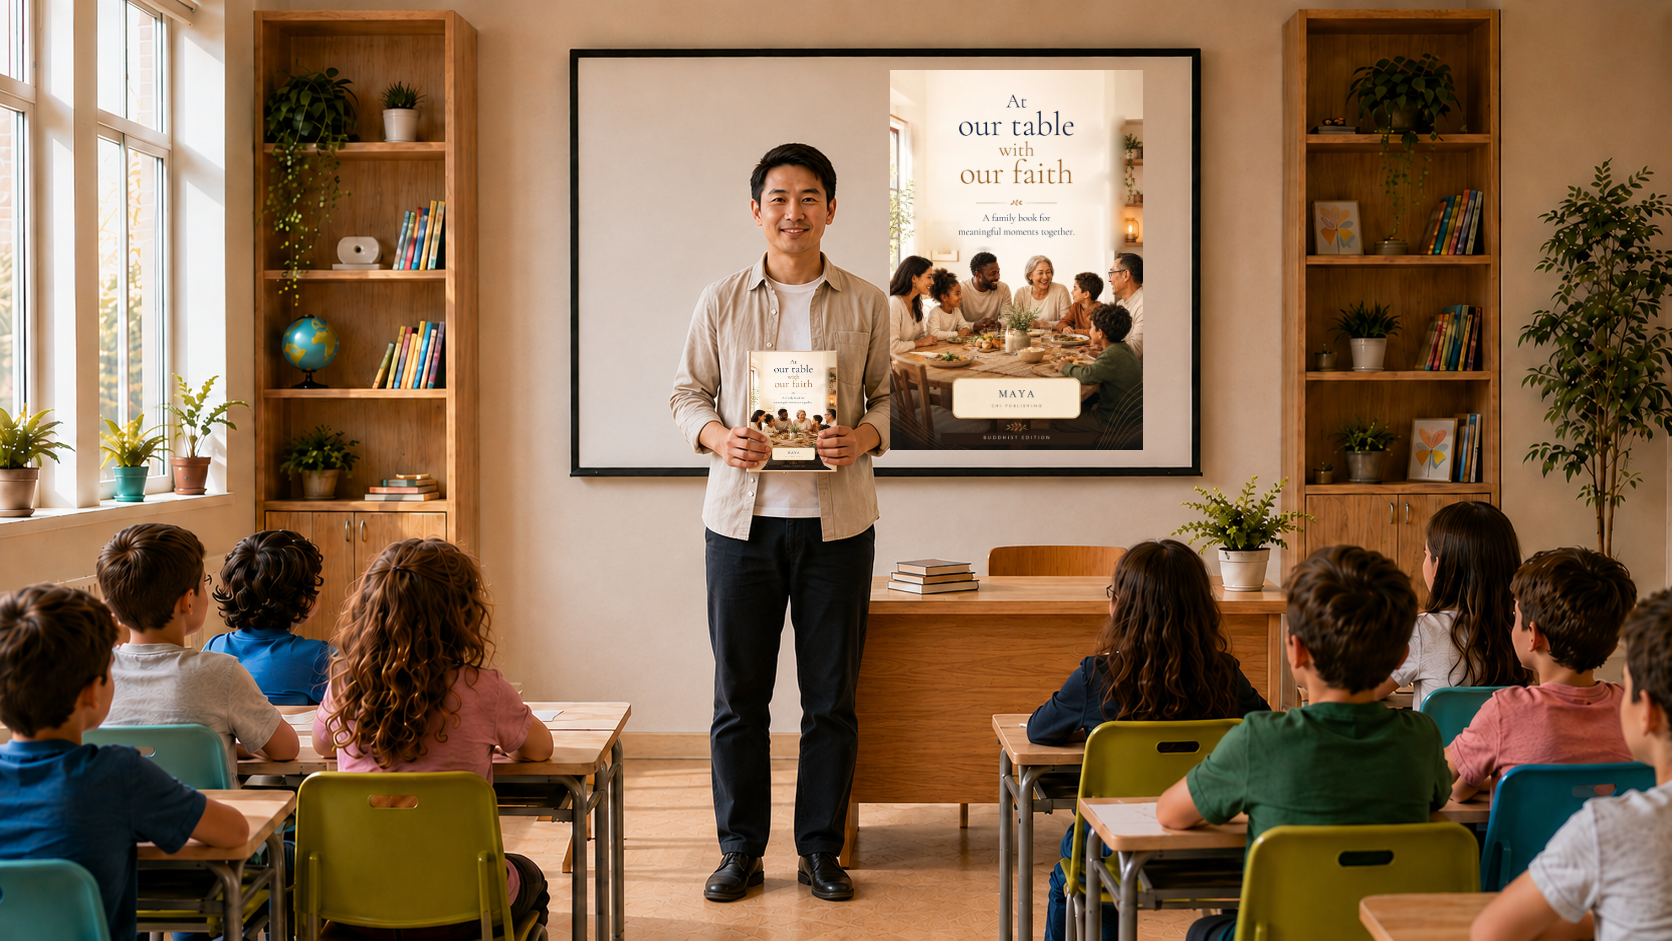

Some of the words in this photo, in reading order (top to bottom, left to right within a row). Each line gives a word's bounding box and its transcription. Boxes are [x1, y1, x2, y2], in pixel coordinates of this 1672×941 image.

[1006, 94, 1028, 108] At
[958, 120, 1002, 136] our
[1012, 110, 1074, 136] table
[998, 140, 1034, 157] with
[960, 168, 1003, 184] our
[1012, 158, 1073, 184] faith
[982, 214, 990, 222] A
[991, 213, 1016, 224] family
[1018, 213, 1037, 222] book
[1039, 213, 1051, 222] for
[958, 227, 1001, 238] meaningful
[1003, 228, 1039, 236] moments
[1041, 227, 1075, 238] together.
[791, 364, 814, 373] table
[792, 379, 813, 388] faith
[998, 389, 1035, 398] MAYA
